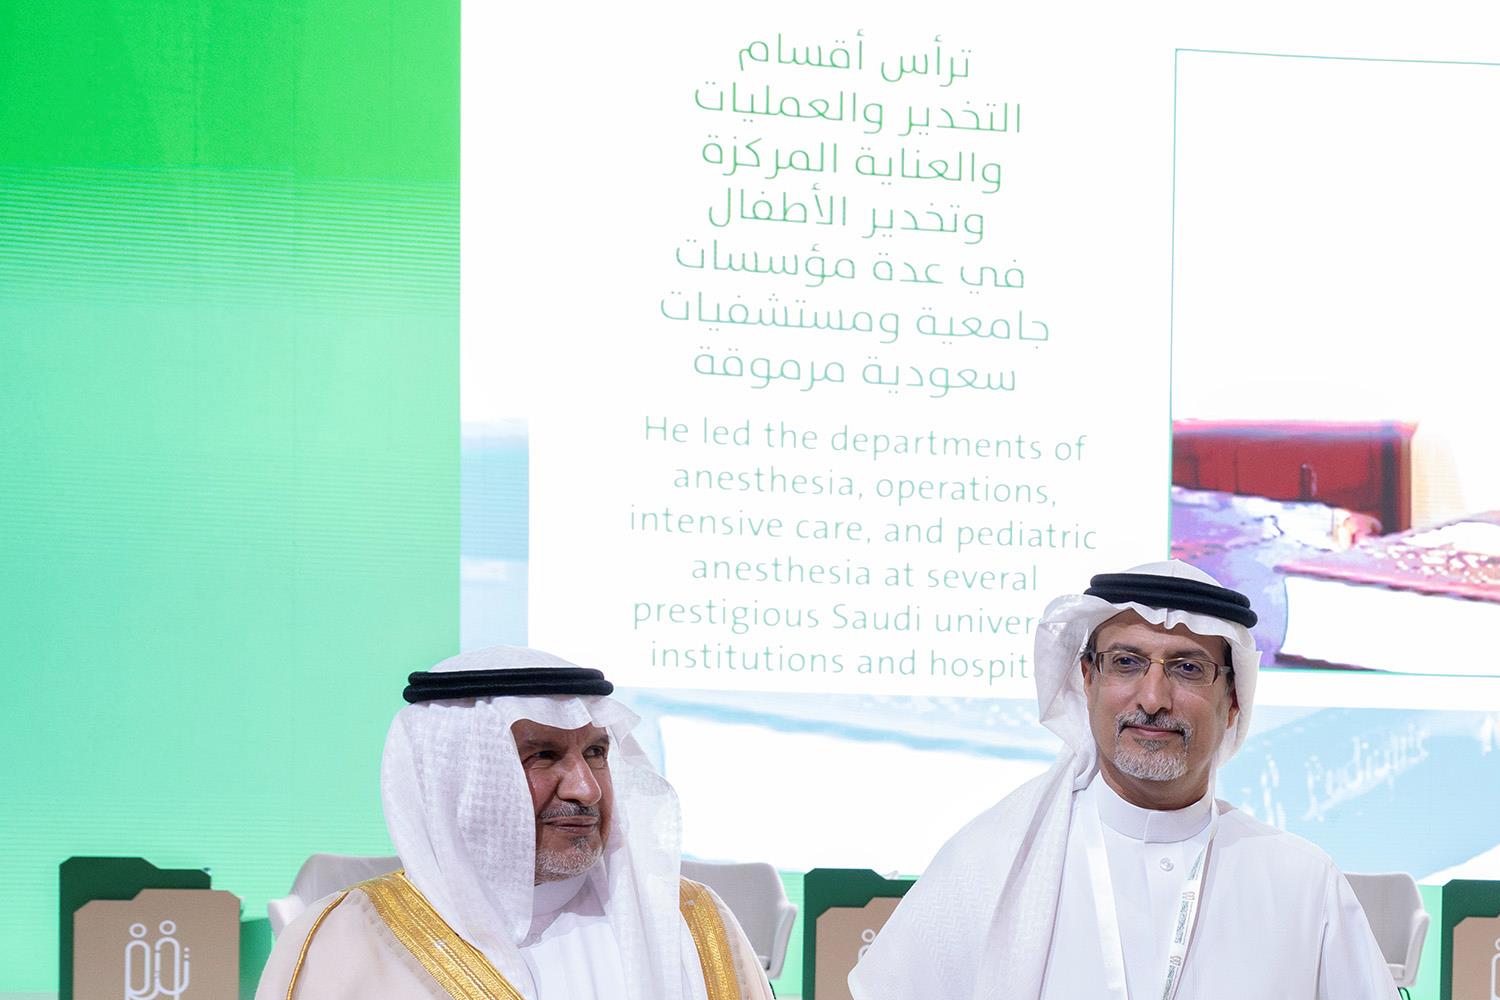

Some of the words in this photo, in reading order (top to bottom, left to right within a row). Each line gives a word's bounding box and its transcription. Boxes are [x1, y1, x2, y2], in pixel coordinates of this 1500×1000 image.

[738, 29, 864, 71] أقسام
[880, 35, 971, 87] ترأس
[695, 81, 883, 134] والعمليات
[898, 101, 1020, 137] التخدير
[702, 134, 837, 180] المركزة
[855, 147, 1001, 194] والعناية
[708, 183, 846, 227] الأطفال
[862, 203, 984, 245] وتخدير
[676, 239, 855, 288] مؤسسات
[873, 253, 943, 284] عدة
[960, 259, 1024, 294] في
[660, 291, 899, 344] ومستشفيات
[916, 307, 1049, 349] جامعية
[694, 346, 844, 392] مرموقة
[862, 356, 1015, 398] سعودية
[646, 416, 688, 442] He
[704, 417, 749, 446] led
[764, 421, 817, 449] the
[831, 425, 1041, 460] departments
[1055, 435, 1086, 461] of
[674, 466, 862, 498] anesthesia,
[876, 477, 1055, 506] operations,
[630, 505, 782, 537] intensive
[796, 520, 870, 543] care,
[885, 517, 942, 543] and
[958, 522, 1096, 553] pediatric
[692, 557, 870, 585] anesthesia
[885, 563, 913, 587] at
[928, 565, 1036, 591] several
[634, 600, 819, 634] prestigious
[833, 604, 919, 631] Saudi
[651, 641, 843, 673] institutions
[857, 650, 915, 675] and
